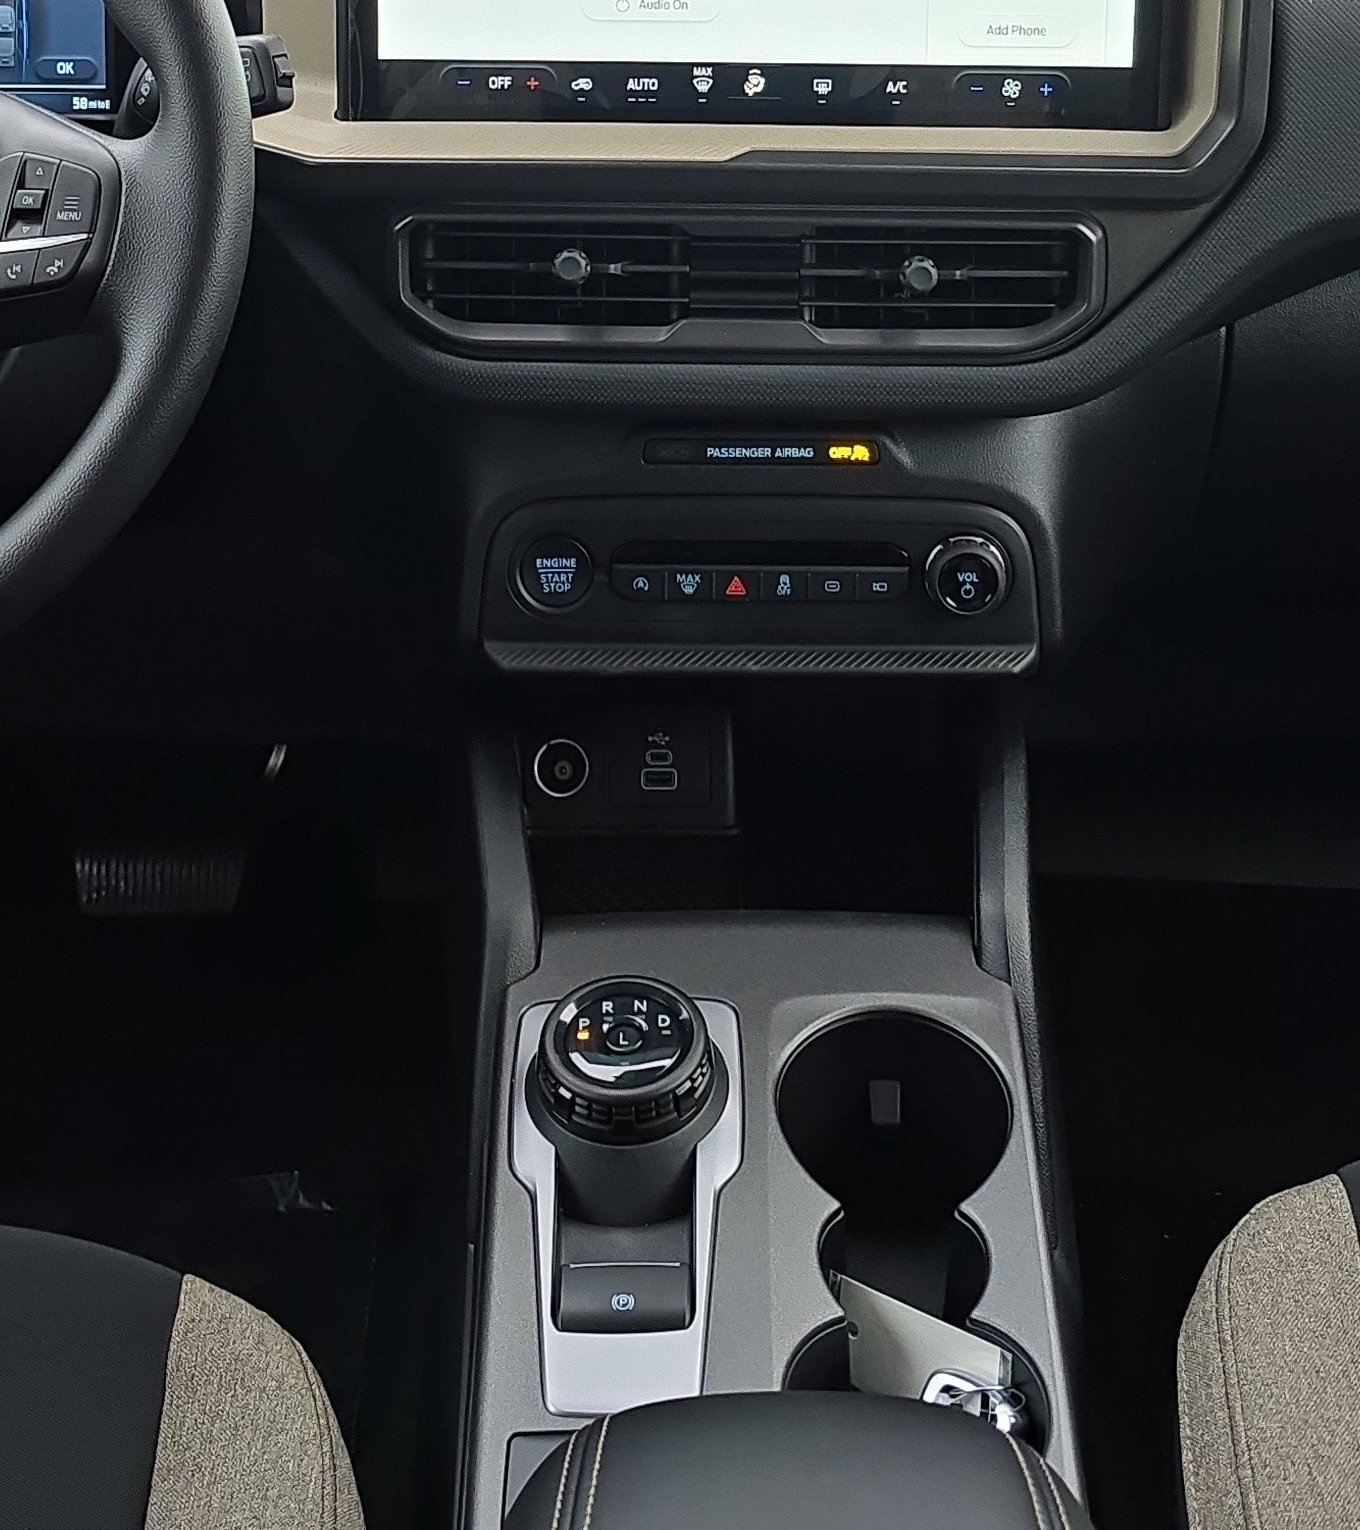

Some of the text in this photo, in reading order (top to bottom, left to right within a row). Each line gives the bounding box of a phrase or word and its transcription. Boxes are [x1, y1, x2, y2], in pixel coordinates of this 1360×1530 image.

[672, 0, 689, 10] On
[986, 25, 1047, 36] Add Phone
[56, 62, 74, 75] OK
[692, 66, 713, 77] MAX
[488, 76, 512, 90] OFF
[626, 78, 658, 91] AUTO
[886, 80, 908, 94] A/C
[72, 97, 88, 110] 58
[22, 196, 34, 205] OK
[56, 210, 82, 221] MENU
[706, 447, 772, 458] PASSENGER
[774, 447, 814, 458] AIRBAG
[536, 558, 577, 568] ENGINE
[540, 573, 574, 583] START
[676, 573, 702, 584] MAX
[956, 572, 980, 582] VOL
[542, 582, 572, 593] STOP
[602, 1000, 614, 1014] R
[634, 1000, 648, 1014] N
[578, 1018, 591, 1031] P
[658, 1014, 671, 1027] D
[619, 1032, 629, 1046] L
